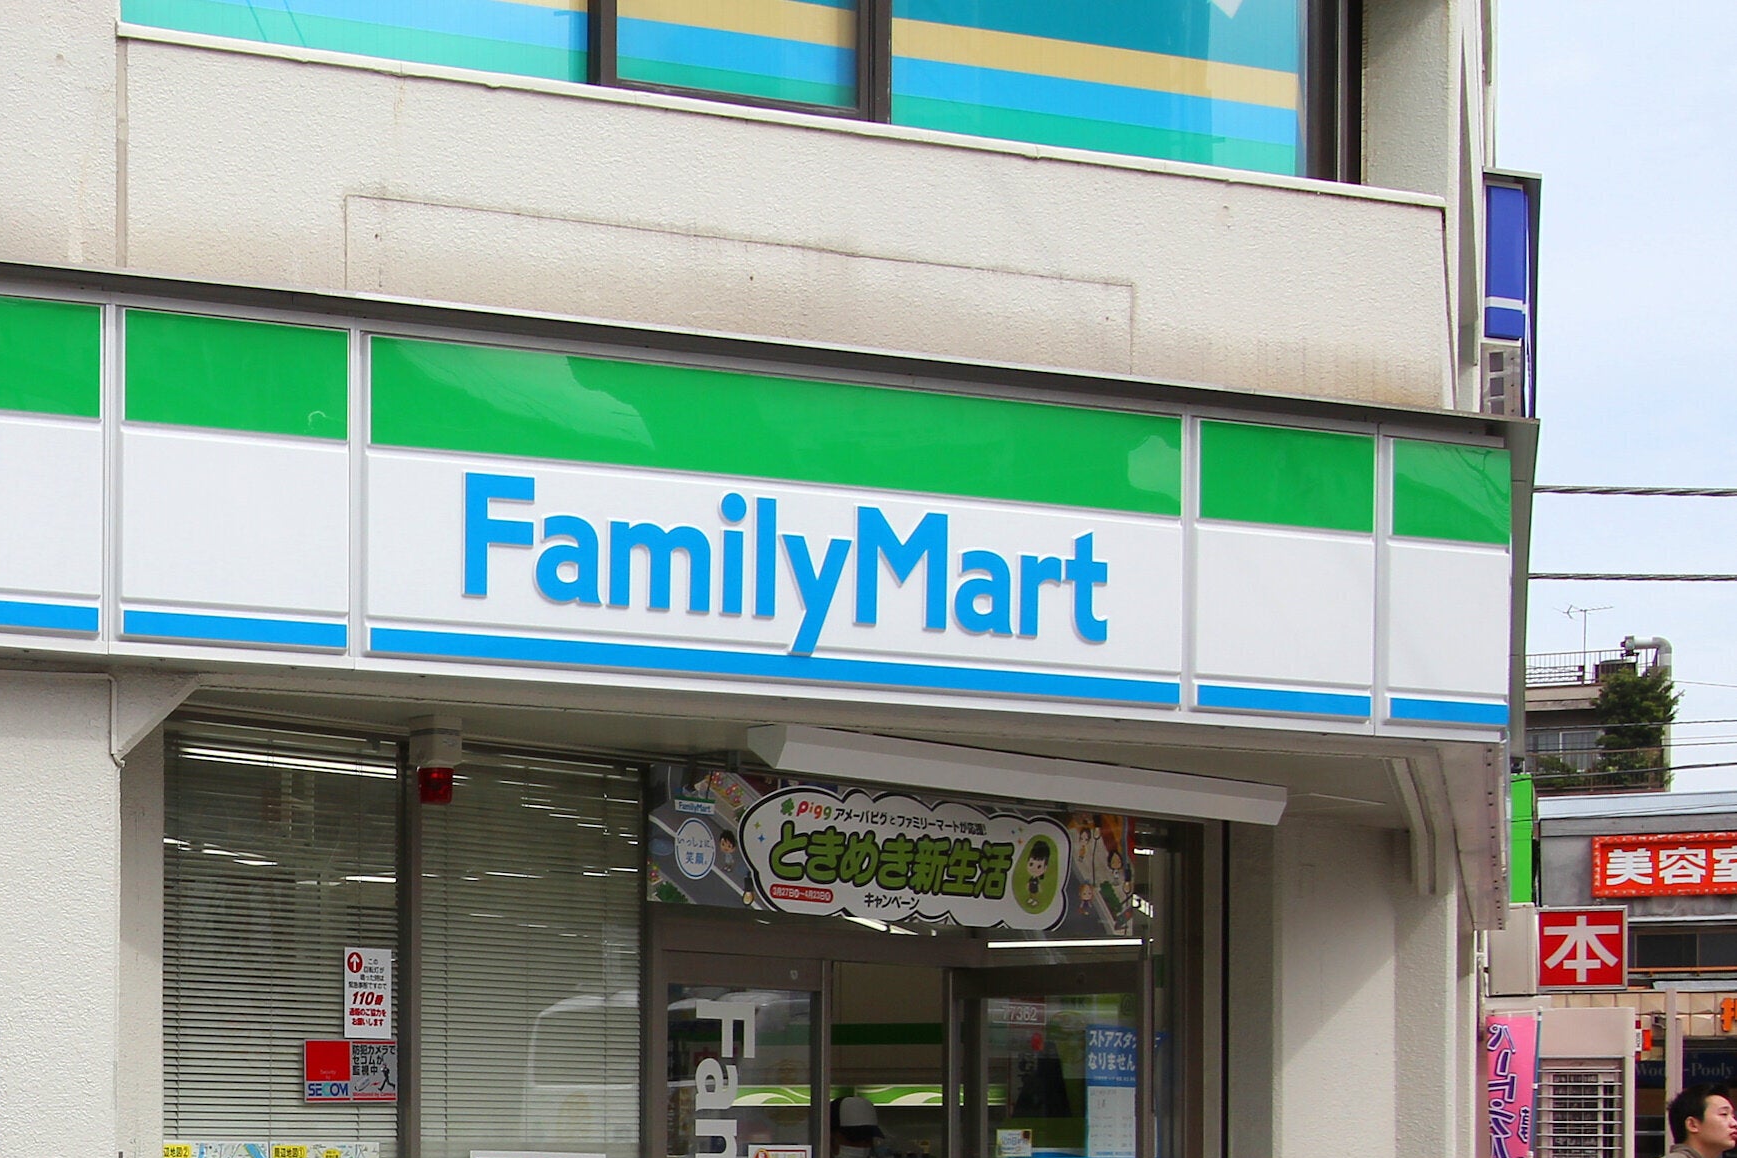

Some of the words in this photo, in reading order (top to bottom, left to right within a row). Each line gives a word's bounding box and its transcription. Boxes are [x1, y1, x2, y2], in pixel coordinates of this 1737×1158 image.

[462, 471, 1111, 657] FamilyMart
[770, 820, 1017, 899] ときめき新生活
[863, 893, 920, 911] キャンペーン
[1544, 915, 1619, 983] 本
[308, 1082, 349, 1097] SECOM
